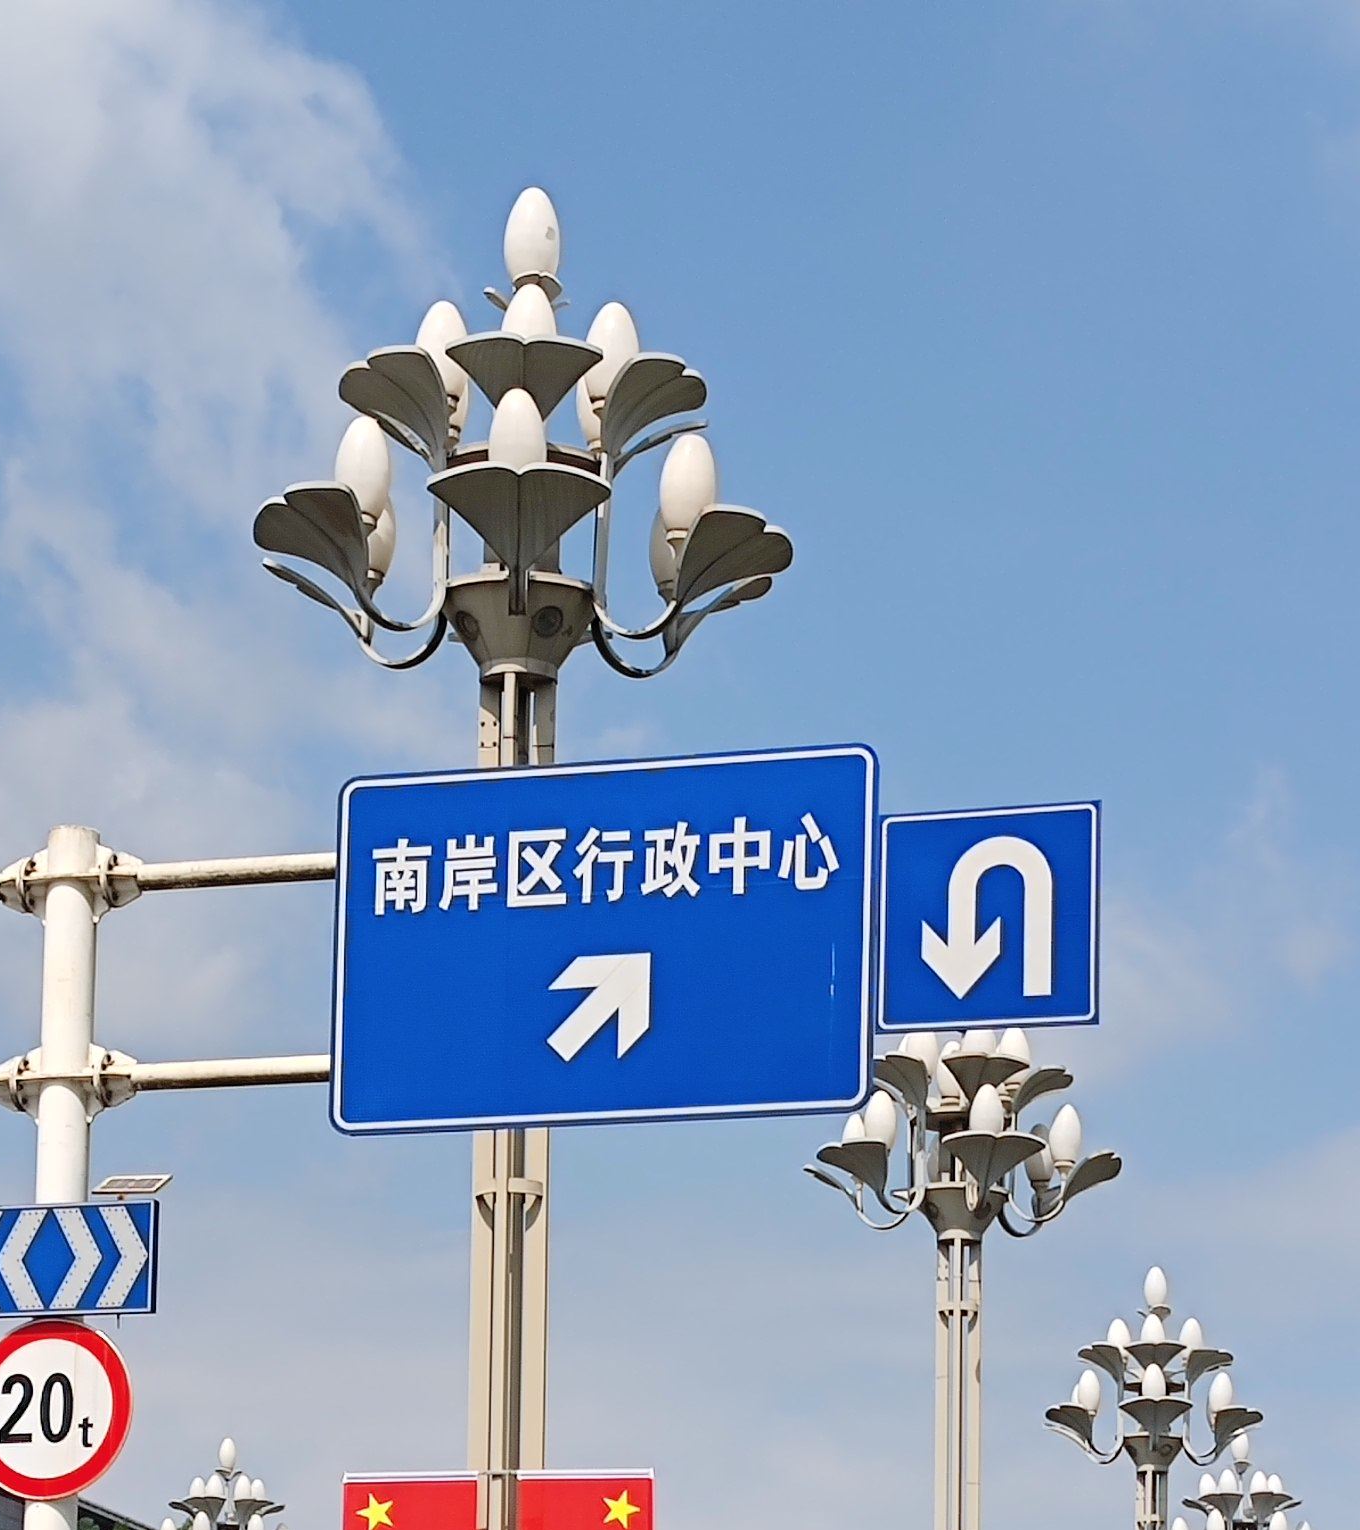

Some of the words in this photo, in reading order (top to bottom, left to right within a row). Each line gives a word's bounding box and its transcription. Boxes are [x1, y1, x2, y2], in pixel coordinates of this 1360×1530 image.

[372, 813, 840, 915] 南岸区行政中心
[0, 1372, 94, 1448] 20t
